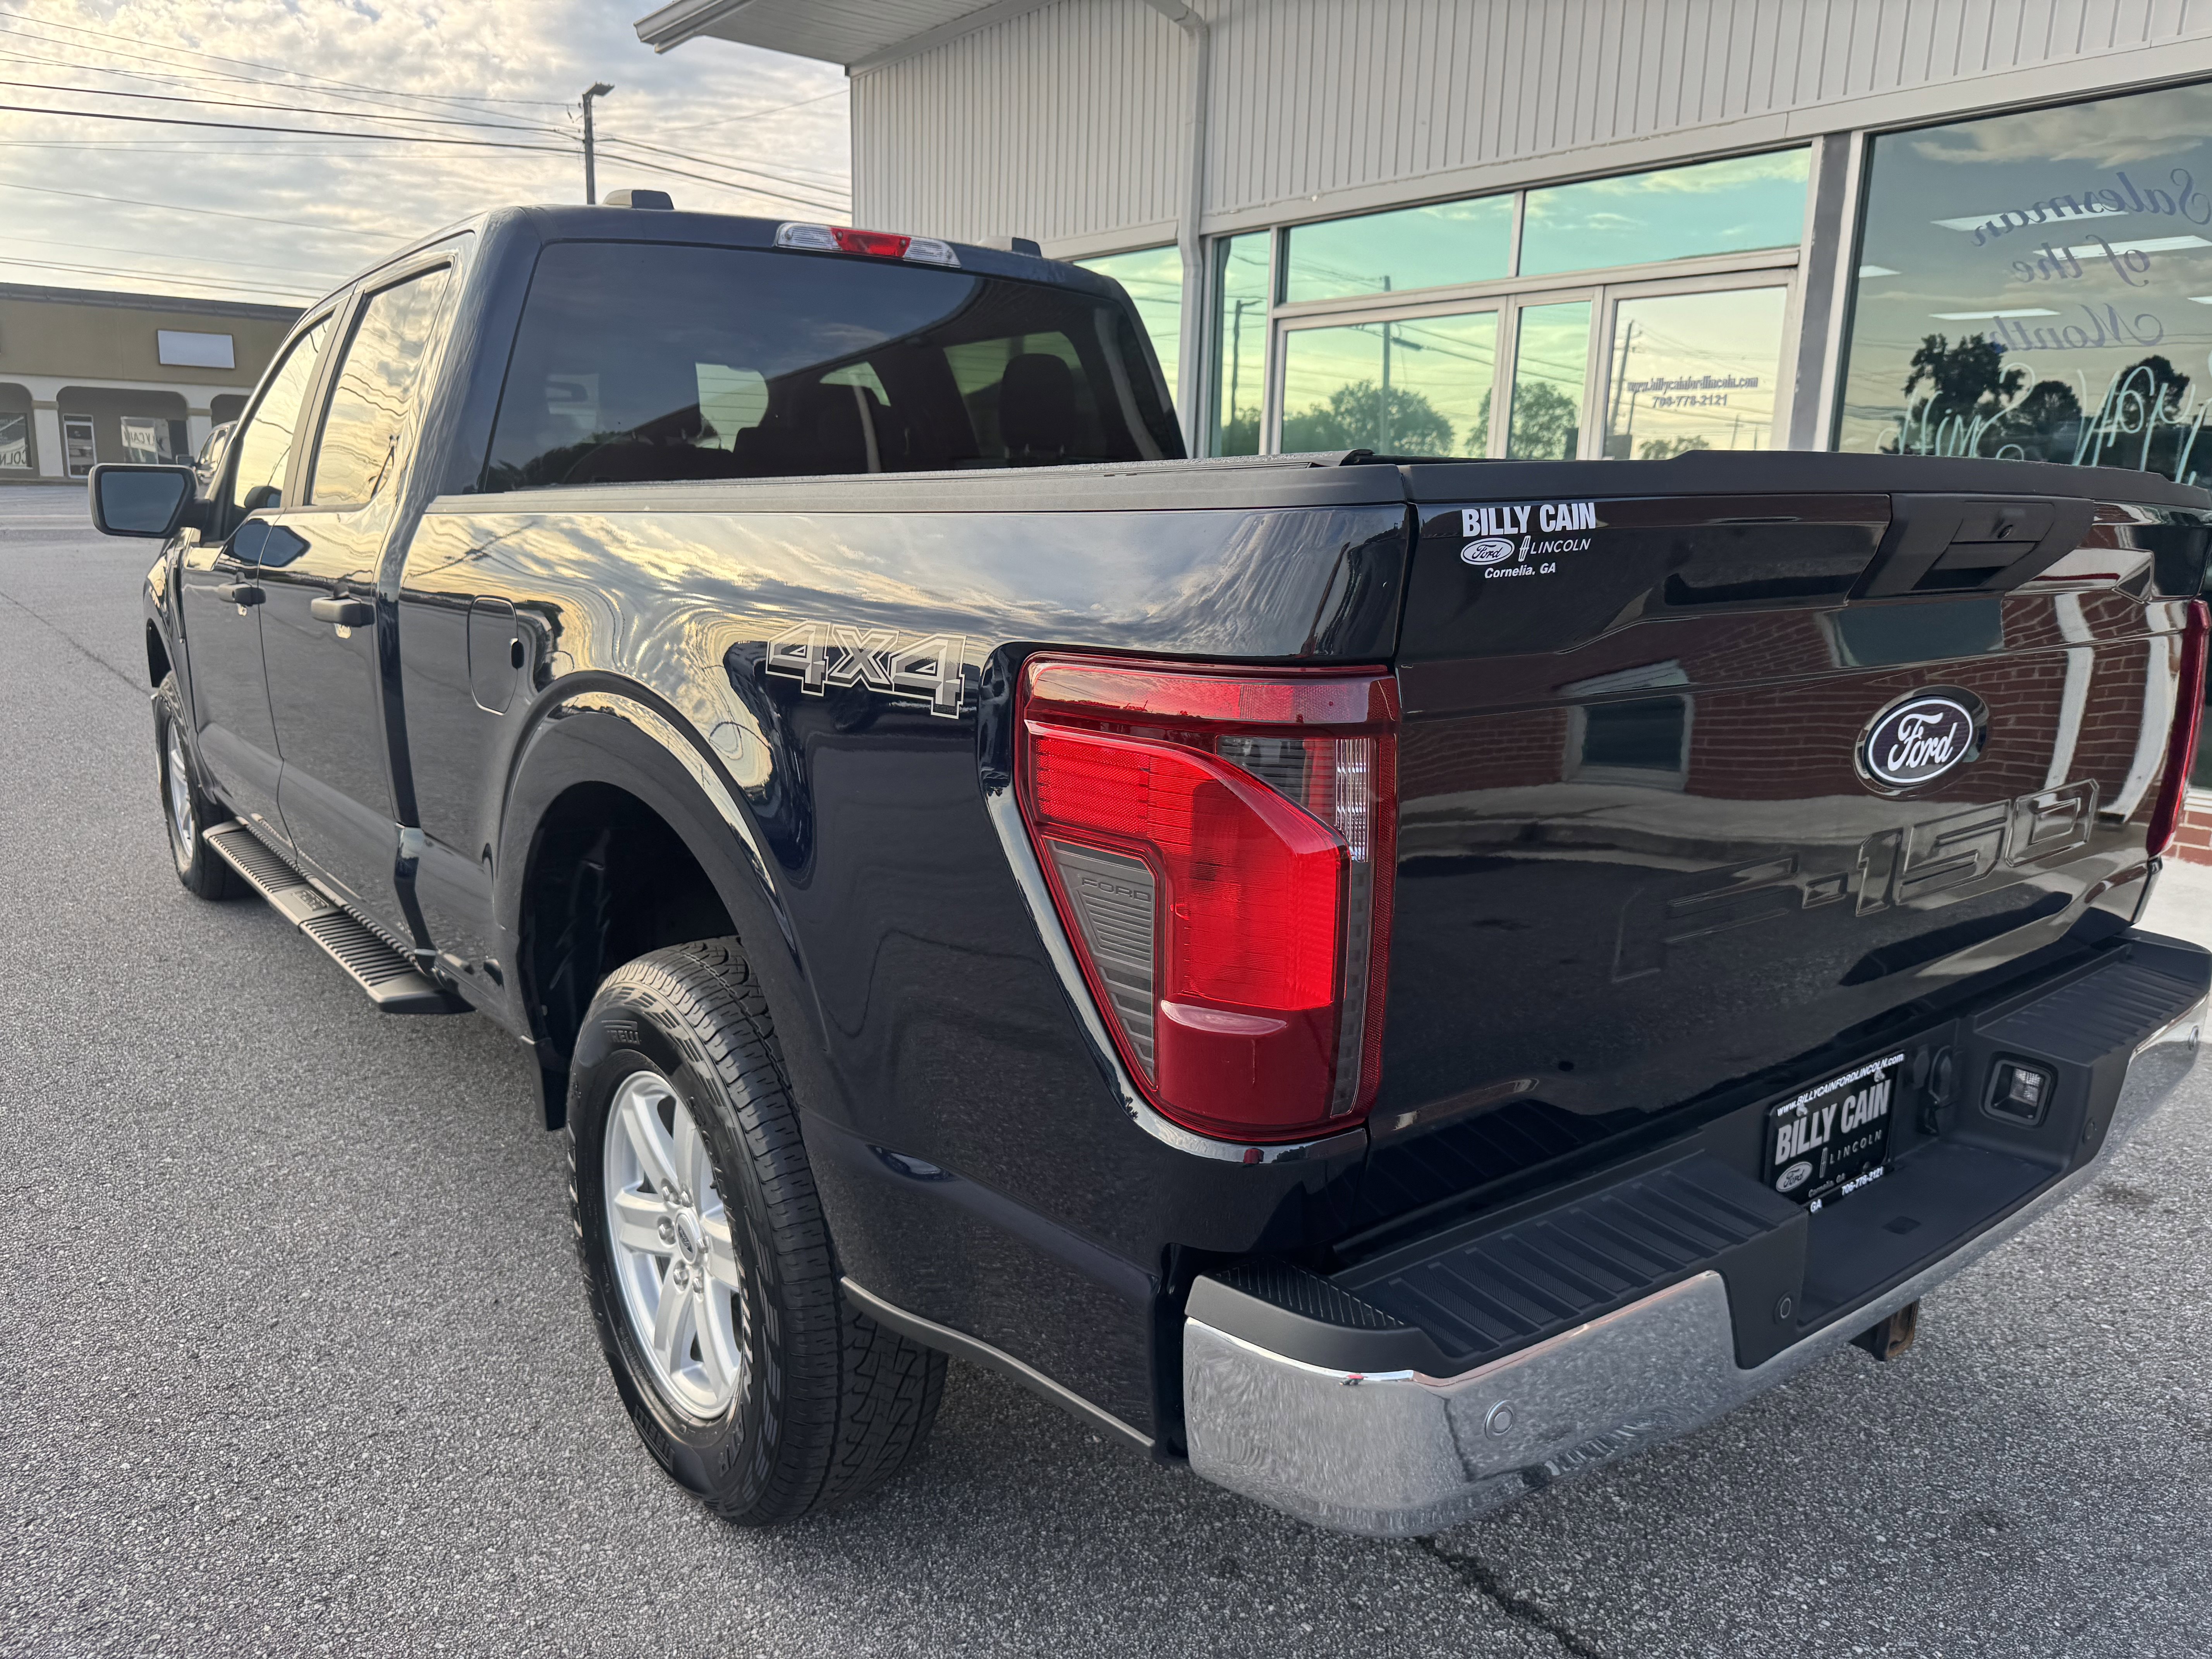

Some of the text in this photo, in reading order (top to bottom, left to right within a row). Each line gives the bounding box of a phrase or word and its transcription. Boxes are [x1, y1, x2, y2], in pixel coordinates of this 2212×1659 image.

[1462, 503, 1596, 537] BILLY CAIN
[1530, 538, 1591, 555] LINCOLN
[1540, 562, 1556, 574] GA
[1888, 712, 1958, 771] Ford
[1082, 877, 1151, 903] FORD
[1612, 779, 2100, 983] F-150
[1775, 1079, 1892, 1166] BILLY CAIN
[1830, 1129, 1882, 1165] LINCOLN
[1810, 1166, 1884, 1213] GA 706-778-2121
